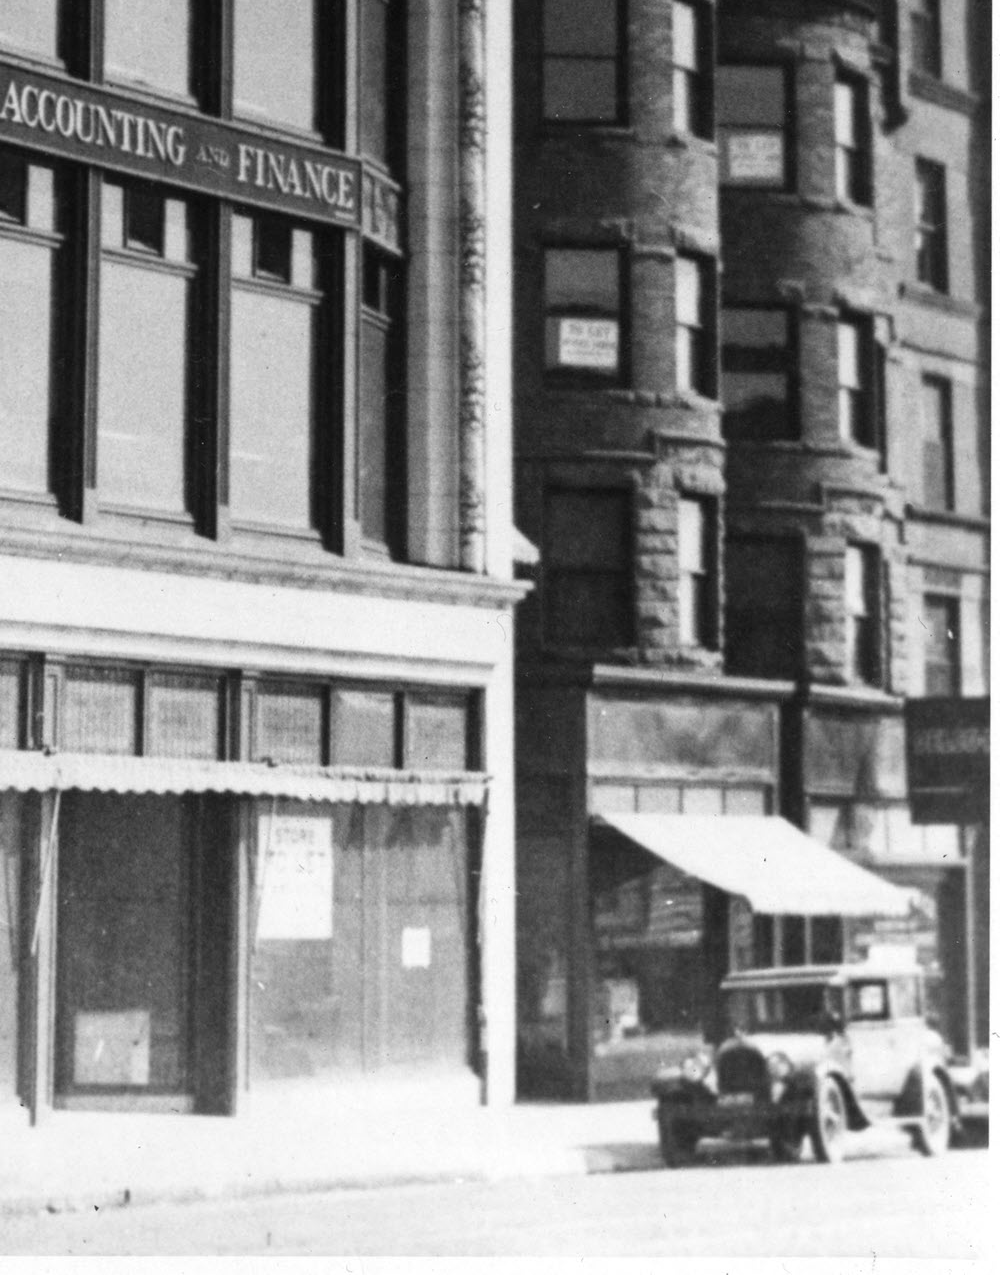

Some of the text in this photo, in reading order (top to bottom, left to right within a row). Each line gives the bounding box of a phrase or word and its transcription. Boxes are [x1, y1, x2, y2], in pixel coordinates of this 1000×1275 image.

[1, 81, 187, 166] ACCOUNTING
[197, 145, 230, 168] AND
[237, 143, 354, 208] FINANCE
